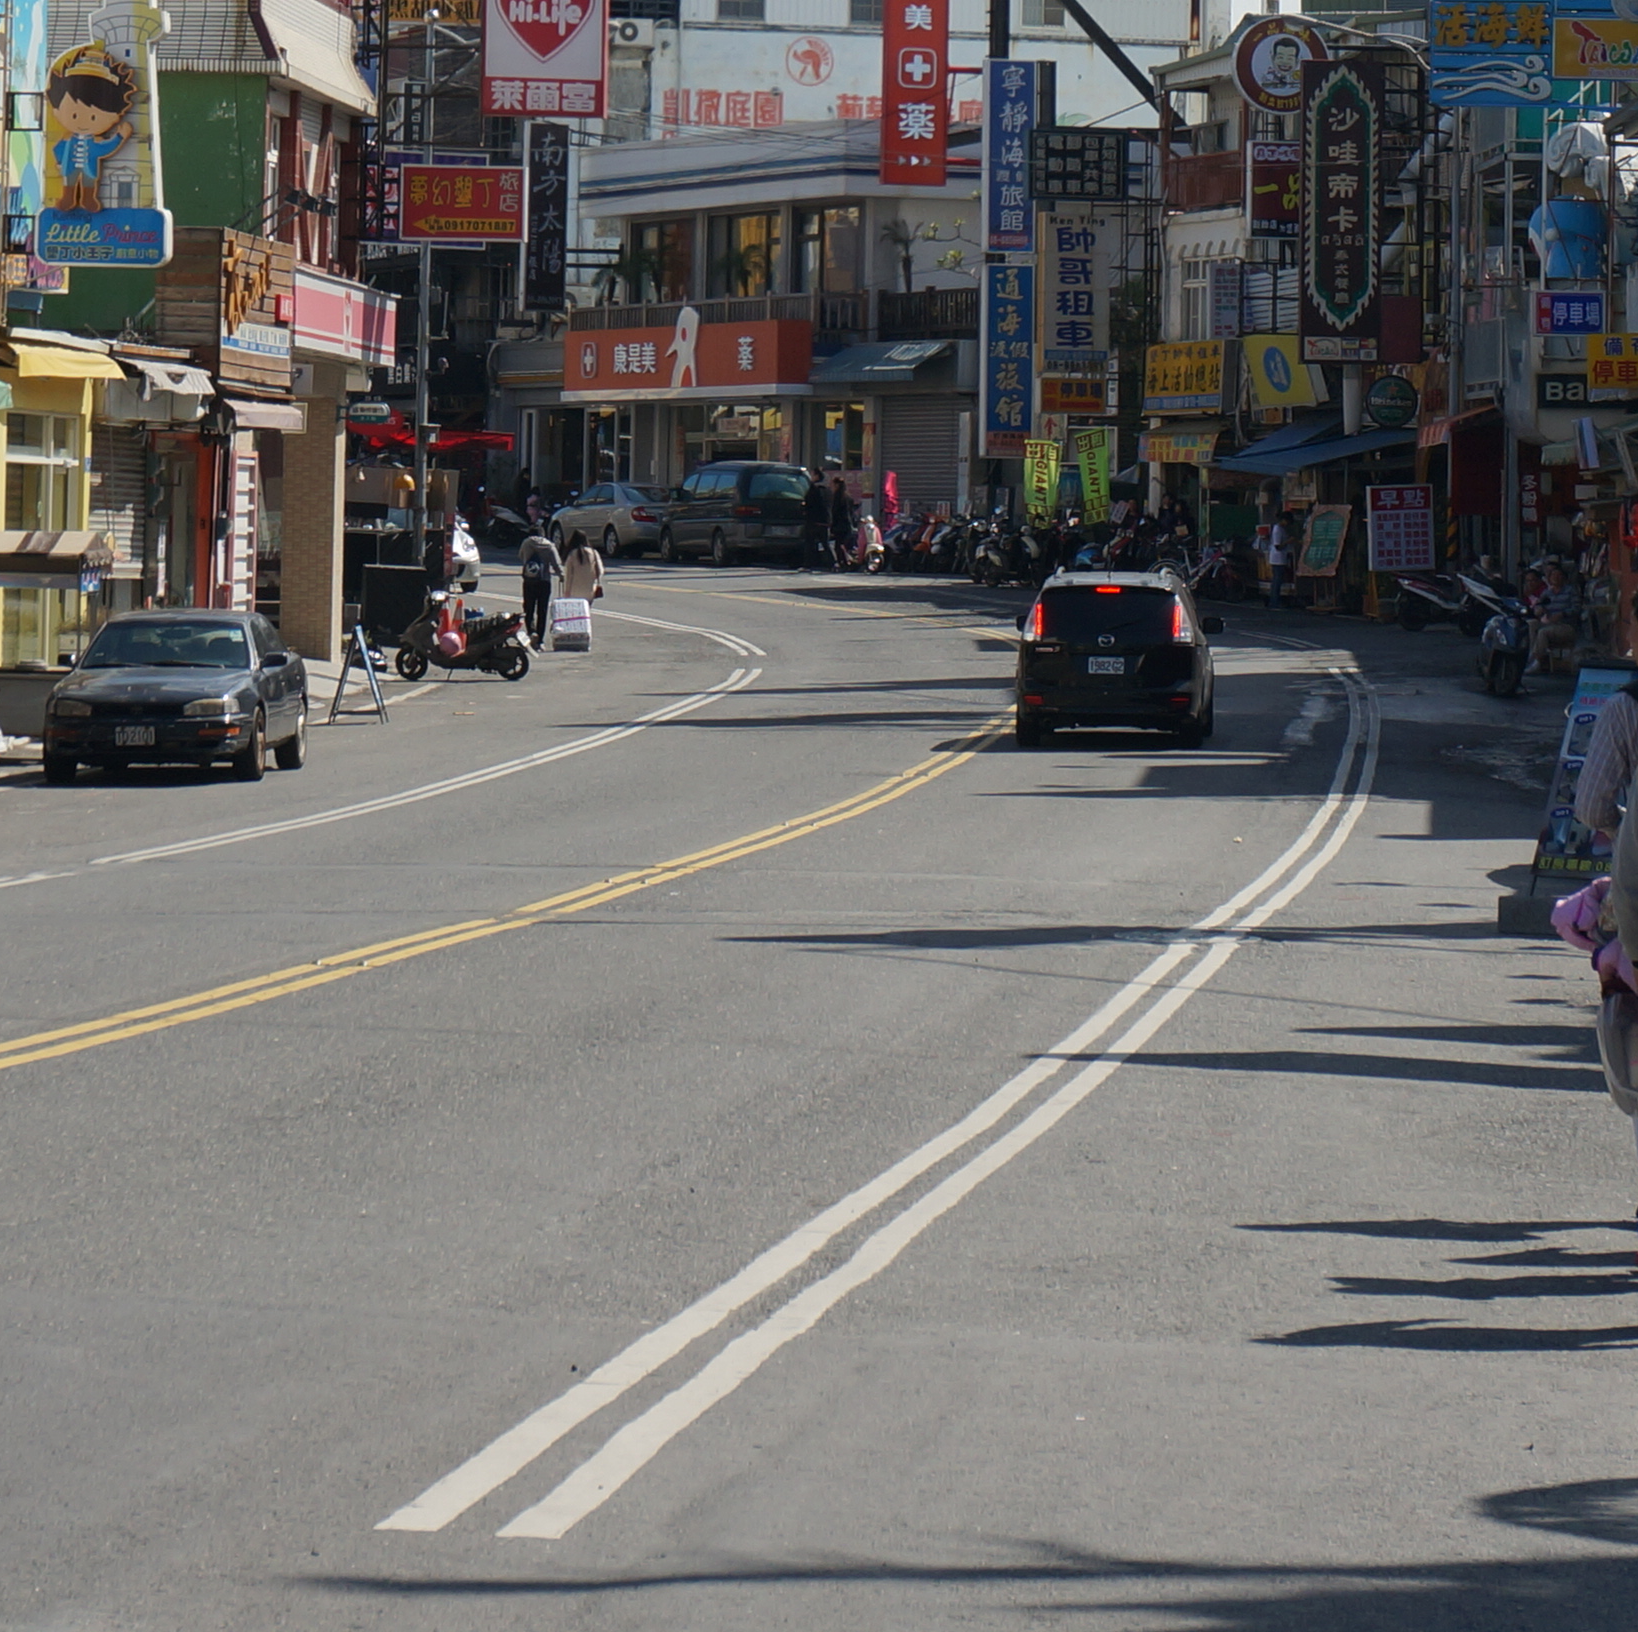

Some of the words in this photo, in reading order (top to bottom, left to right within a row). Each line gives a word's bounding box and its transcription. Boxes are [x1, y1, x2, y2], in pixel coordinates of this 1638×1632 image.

[1434, 2, 1549, 49] 活海鮮
[489, 79, 597, 114] 萊爾富
[1328, 106, 1361, 233] 沙哇帝卡
[409, 175, 495, 209] 夢幻墾丁
[498, 171, 520, 213] 旅店
[999, 183, 1026, 233] 旅館
[44, 223, 101, 244] Little
[101, 223, 160, 244] Prince
[1056, 226, 1097, 350] 帥哥租車
[1552, 301, 1602, 327] 停車場
[612, 340, 657, 375] 康是美
[1085, 451, 1101, 496] GIANT
[1377, 488, 1426, 509] 早點
